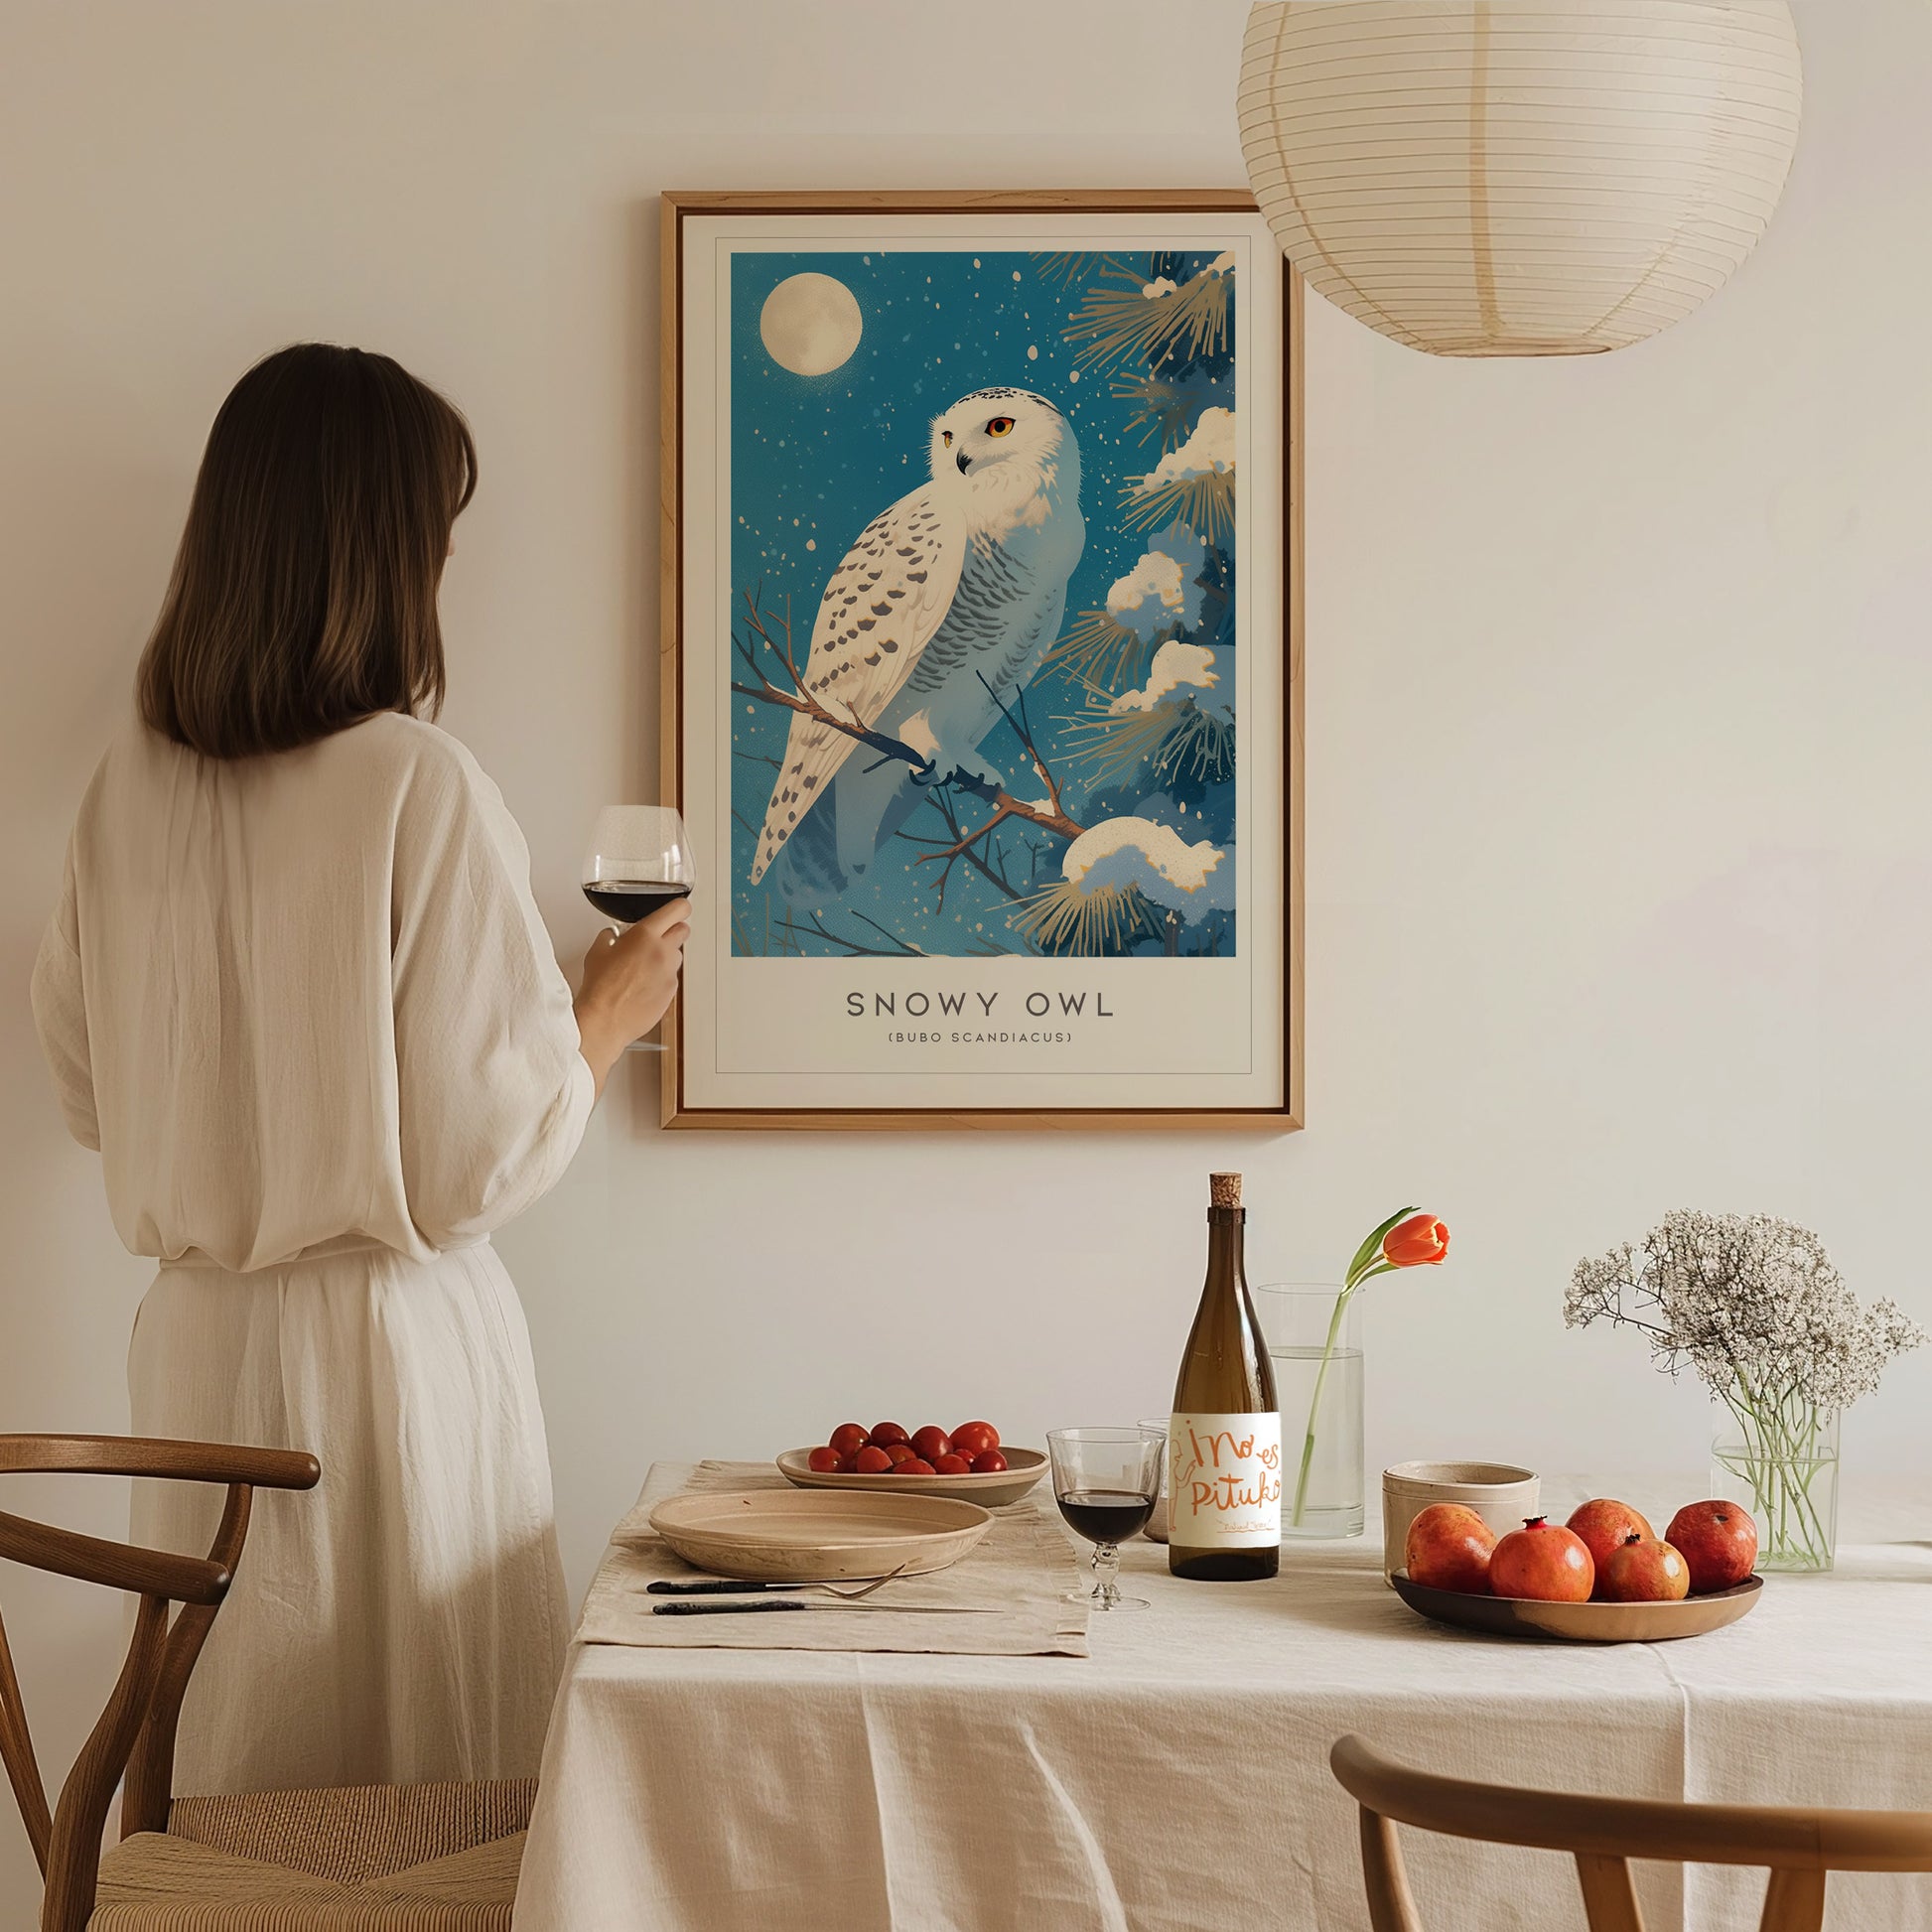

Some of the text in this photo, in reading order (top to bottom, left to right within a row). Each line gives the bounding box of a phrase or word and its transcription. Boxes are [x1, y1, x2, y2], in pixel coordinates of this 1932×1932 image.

[846, 992, 1114, 1017] SNOWY OWL
[889, 1032, 1072, 1042] (BUBO SCANDIACUS)
